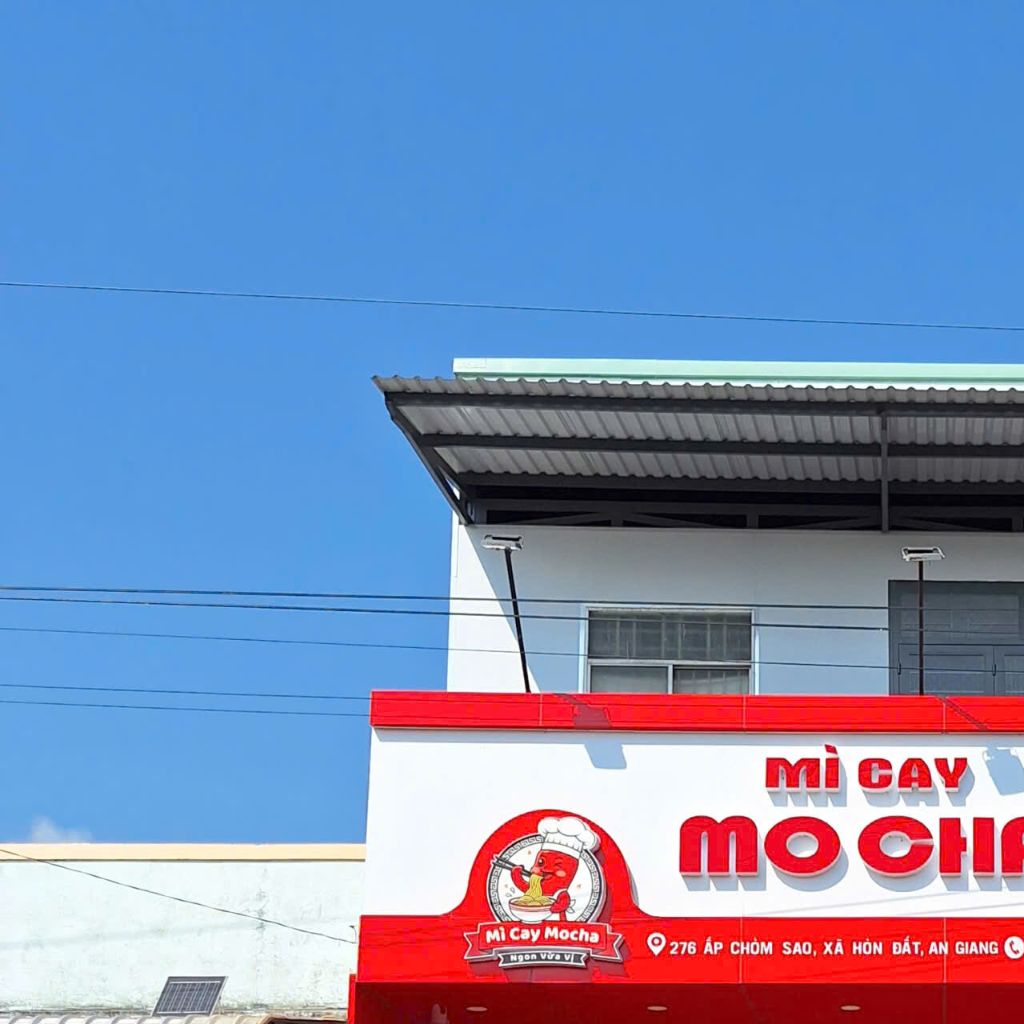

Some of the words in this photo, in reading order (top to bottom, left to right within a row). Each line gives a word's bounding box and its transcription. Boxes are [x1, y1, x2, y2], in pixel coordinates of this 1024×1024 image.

[765, 744, 840, 790] MÌ
[858, 757, 967, 791] CAY
[485, 927, 506, 943] Mì
[509, 927, 541, 943] Cay
[544, 927, 600, 944] Mocha
[669, 941, 697, 955] 276
[730, 937, 773, 955] CHÒM
[782, 941, 817, 957] SAO,
[823, 938, 844, 955] XÃ
[852, 938, 883, 955] HÒN
[928, 941, 948, 955] AN
[955, 941, 998, 955] GIANG
[510, 953, 537, 962] Ngon
